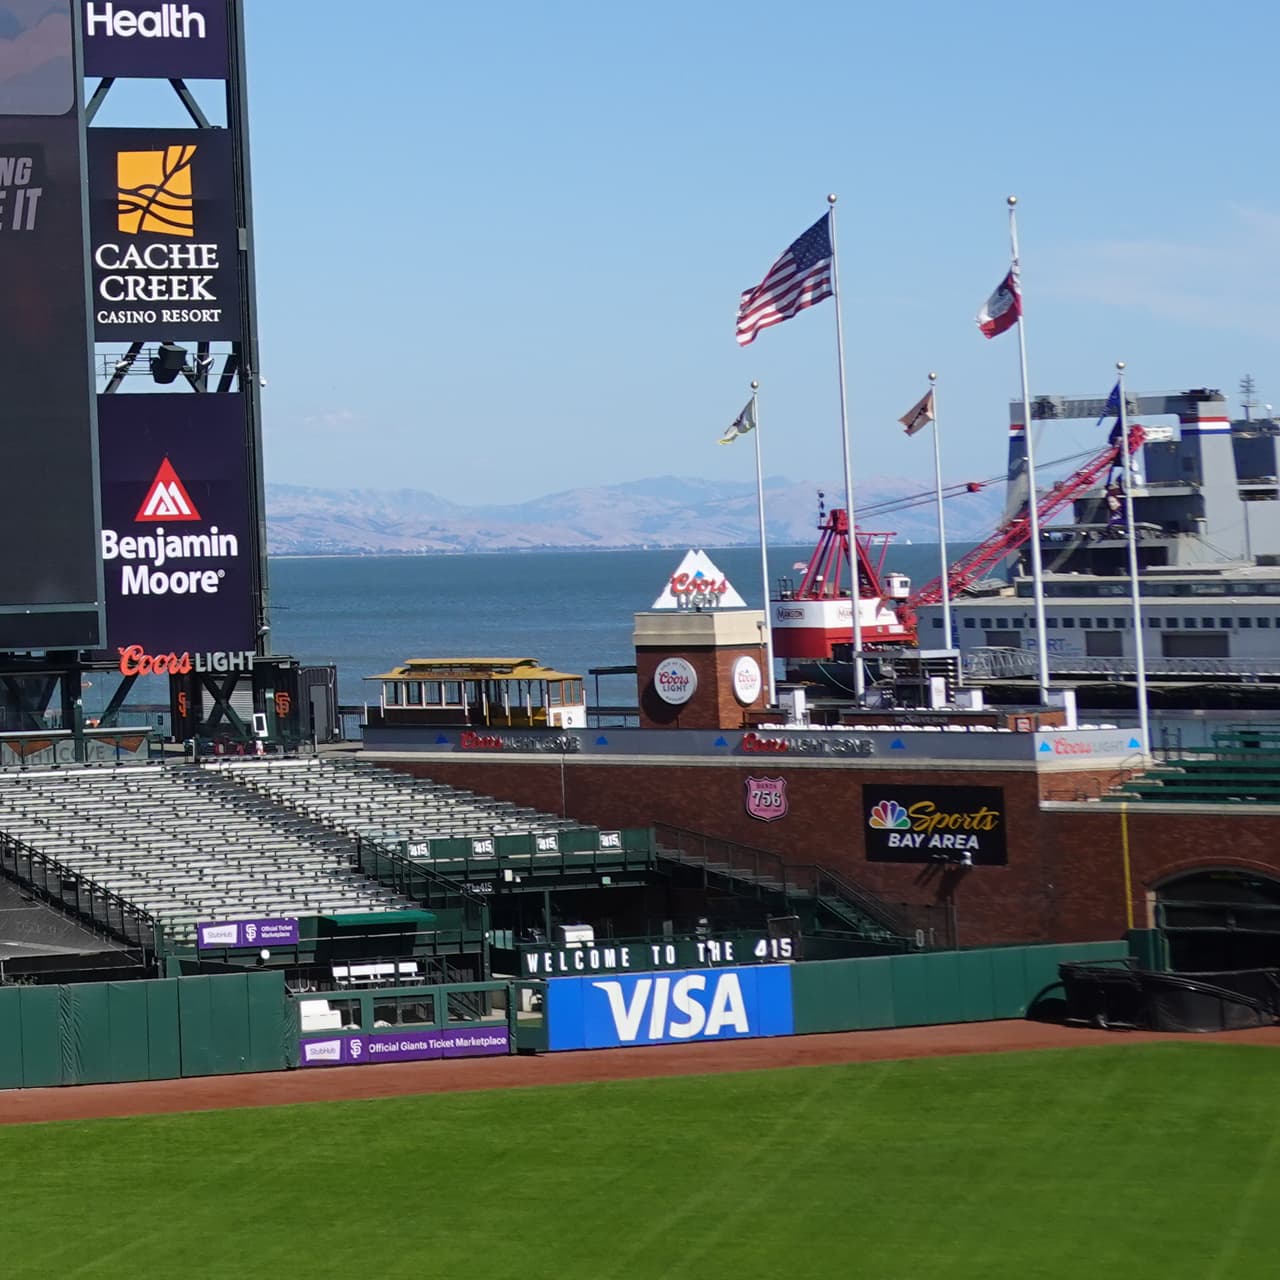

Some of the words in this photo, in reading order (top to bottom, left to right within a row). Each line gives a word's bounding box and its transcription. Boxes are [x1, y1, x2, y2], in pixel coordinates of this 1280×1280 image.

[87, 2, 206, 38] Health
[12, 187, 43, 231] IT
[95, 243, 219, 270] CACHE
[99, 275, 217, 302] CREEK
[97, 309, 157, 324] CASINO
[162, 308, 222, 323] RESORT
[101, 526, 238, 567] Benjamin
[670, 572, 728, 594] Coors
[1025, 638, 1066, 651] PRT
[118, 644, 193, 676] Coors
[195, 650, 257, 673] LIGHT
[659, 671, 689, 685] Coors
[743, 732, 789, 752] Coors
[1054, 737, 1093, 755] Coors
[1093, 740, 1125, 753] LIGHT
[752, 790, 781, 807] 756
[908, 800, 1000, 835] Sports
[888, 832, 925, 849] BAY
[927, 833, 979, 850] AREA
[207, 929, 232, 938] StubHub
[527, 947, 629, 973] WELCOME
[652, 945, 675, 965] TO
[697, 940, 734, 962] THE
[754, 938, 792, 957] 415
[592, 973, 749, 1041] VISA
[309, 1046, 336, 1056] StubHub
[369, 1042, 399, 1053] Official
[400, 1039, 428, 1051] Giants
[429, 1037, 454, 1049] Ticket
[455, 1035, 507, 1049] Marketplace
